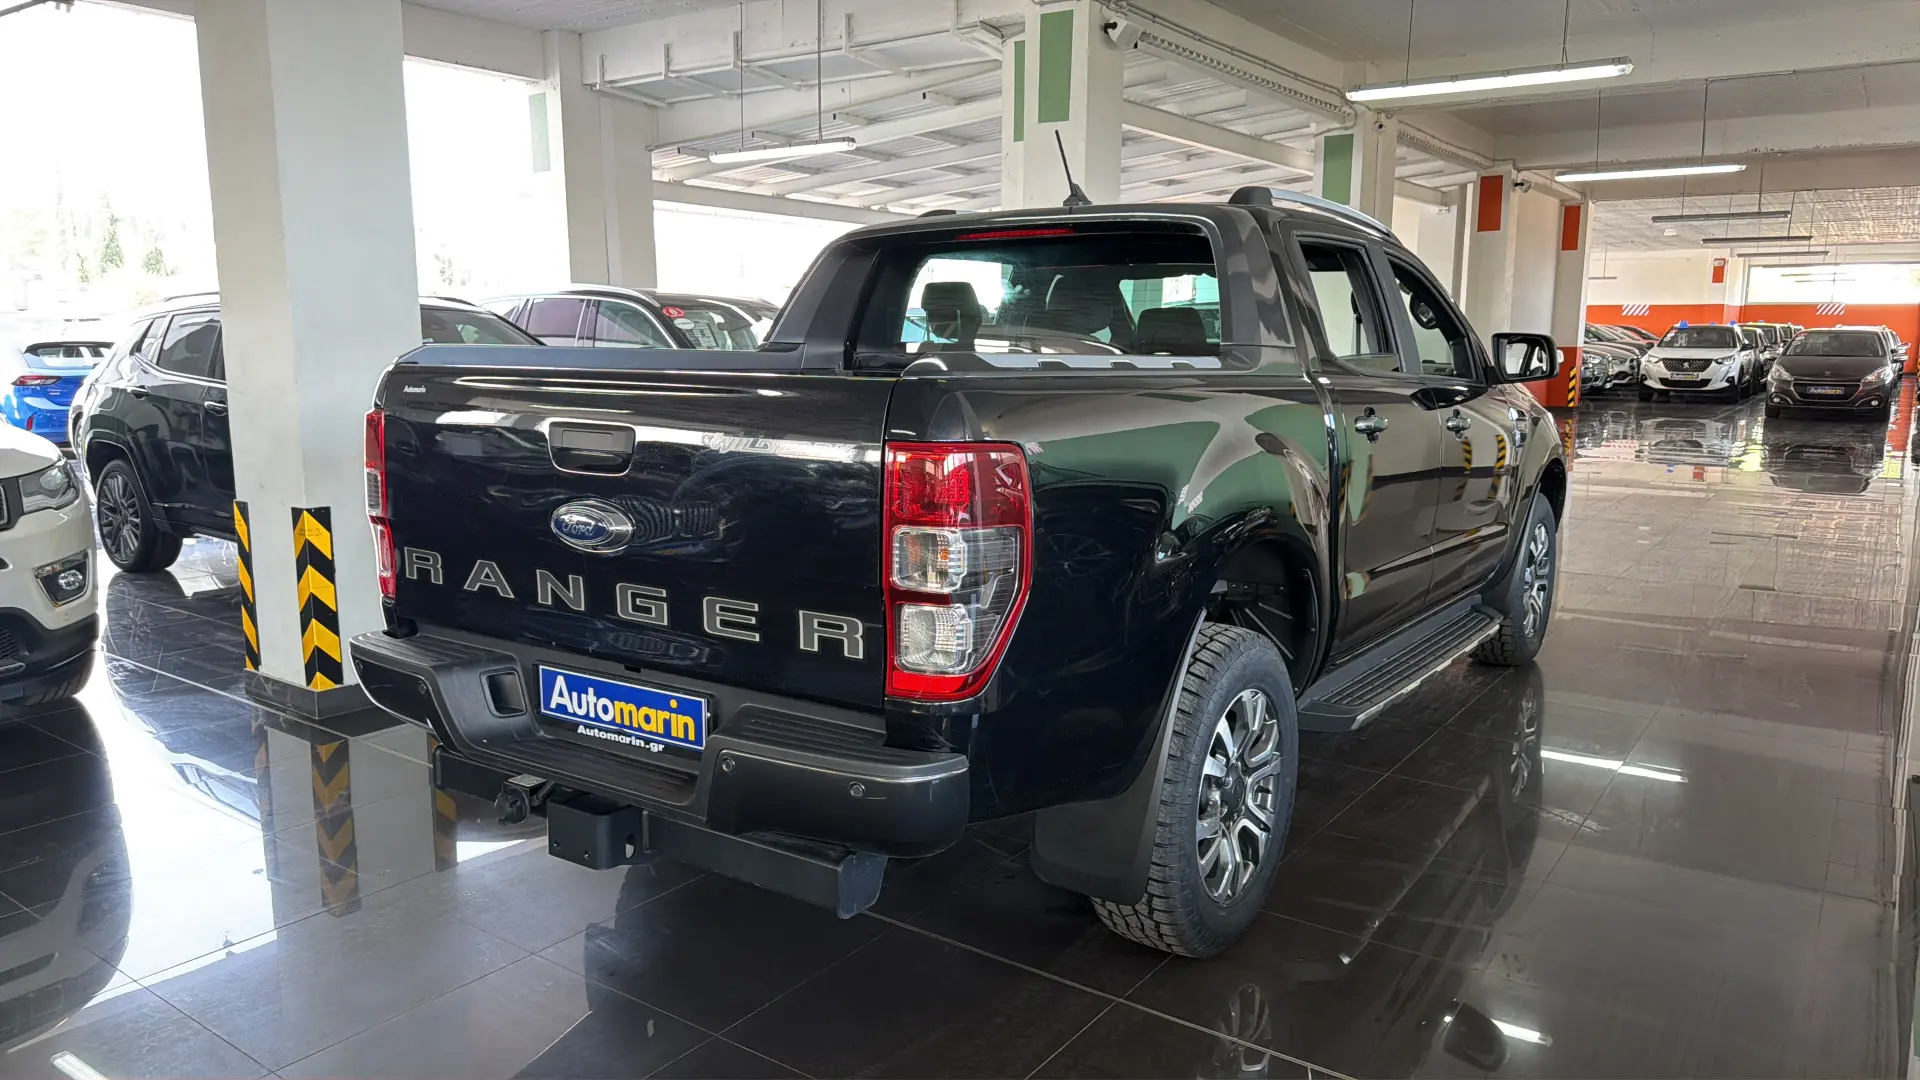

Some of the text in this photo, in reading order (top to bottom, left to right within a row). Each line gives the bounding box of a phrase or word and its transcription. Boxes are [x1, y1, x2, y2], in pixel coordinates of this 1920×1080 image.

[561, 516, 595, 537] Ford
[404, 547, 864, 660] RANGER
[550, 675, 695, 741] Automarin
[577, 725, 665, 752] Automarin.gr
